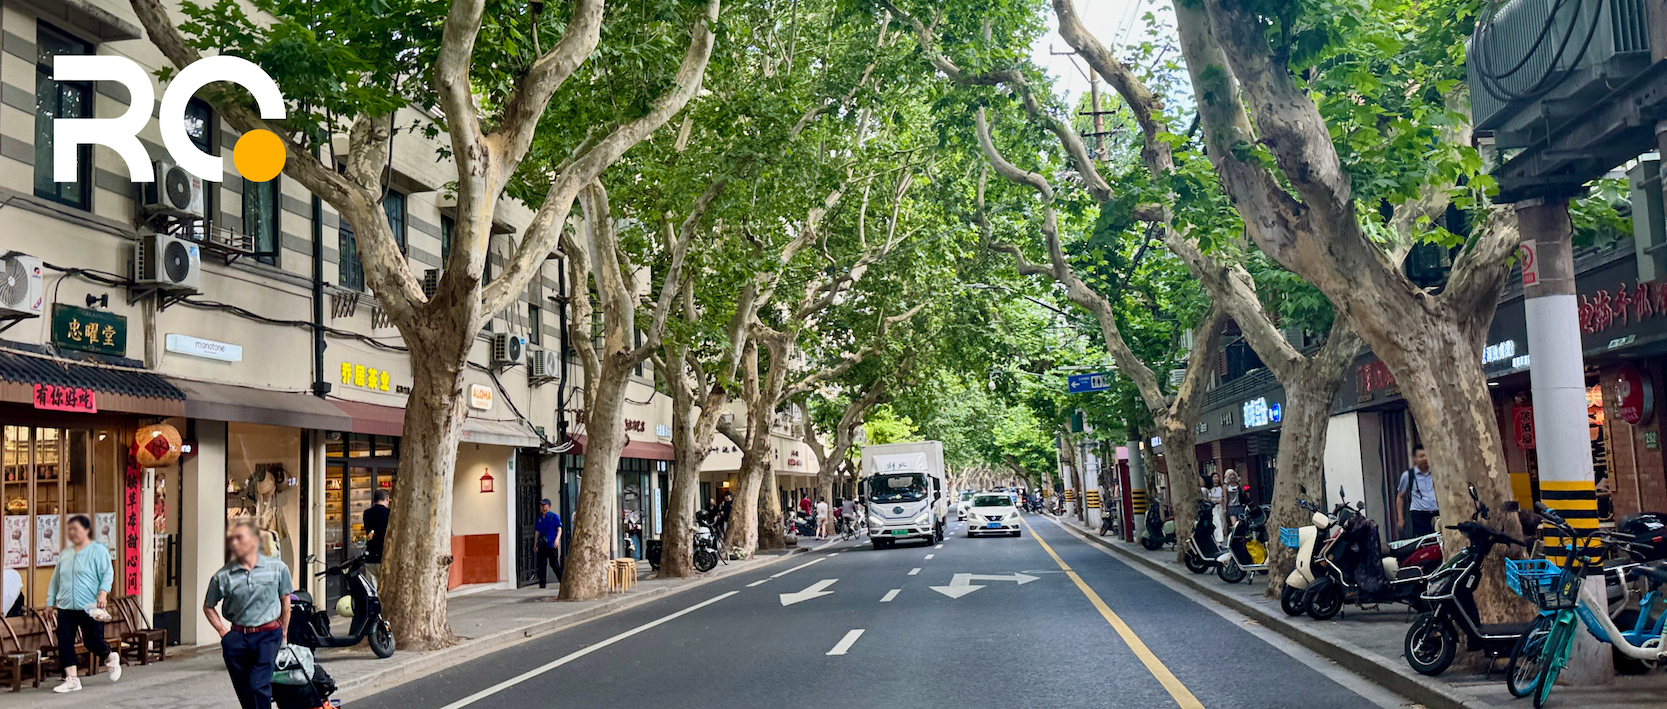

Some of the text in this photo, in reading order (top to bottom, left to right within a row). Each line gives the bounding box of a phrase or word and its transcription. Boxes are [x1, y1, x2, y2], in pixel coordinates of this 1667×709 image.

[67, 317, 116, 347] 忠曜堂
[195, 341, 226, 352] monotone
[37, 387, 93, 409] 有你好吃
[473, 388, 491, 400] ALOHA
[1520, 410, 1533, 444] 居酒屋
